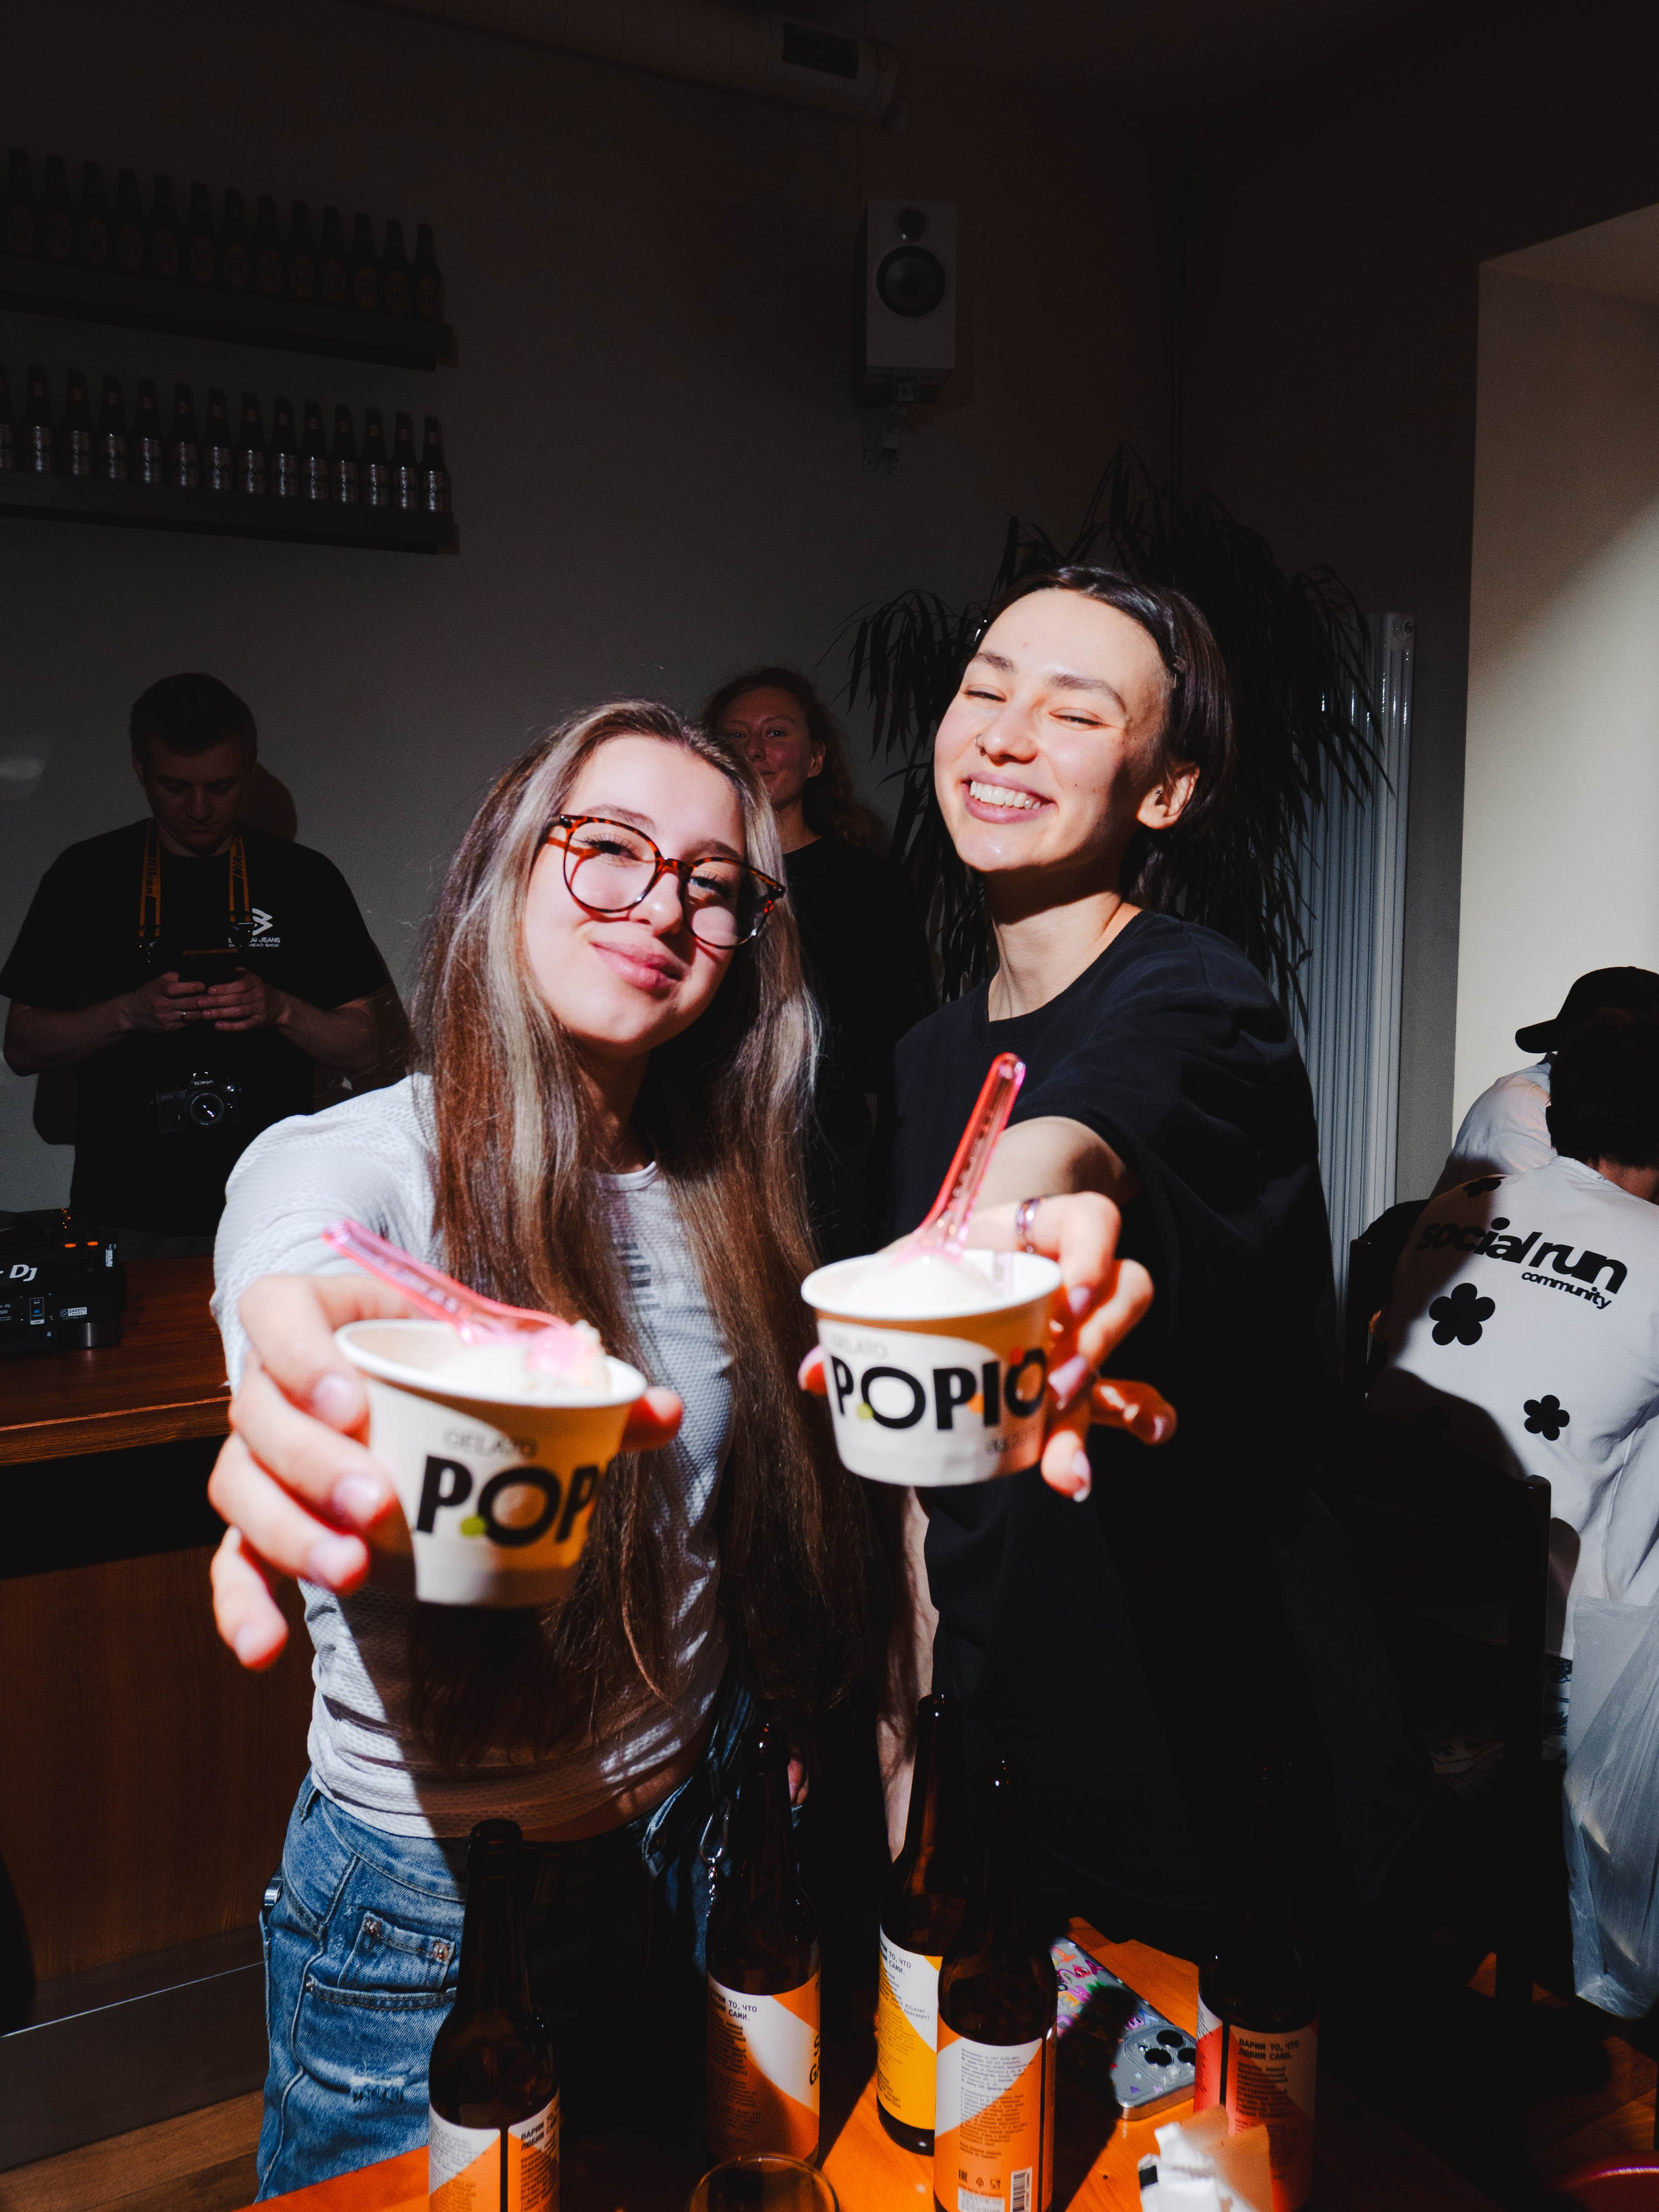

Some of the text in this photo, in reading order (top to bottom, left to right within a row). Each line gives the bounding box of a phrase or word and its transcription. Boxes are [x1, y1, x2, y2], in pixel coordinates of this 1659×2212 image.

[233, 840, 243, 879] Nikon
[146, 857, 157, 895] Nikon
[1522, 1272, 1612, 1309] community
[899, 1958, 911, 1969] ЧТО
[728, 2000, 740, 2010] ТО,
[742, 2004, 757, 2013] ЧТО
[905, 2004, 925, 2013] Pilsner
[728, 2010, 750, 2021] САМИ.
[1239, 2038, 1266, 2050] ВАРИМ
[1285, 2040, 1299, 2049] ЧТО
[521, 2121, 544, 2141] ВАРИМ
[521, 2132, 544, 2151] ЛЮБИМ
